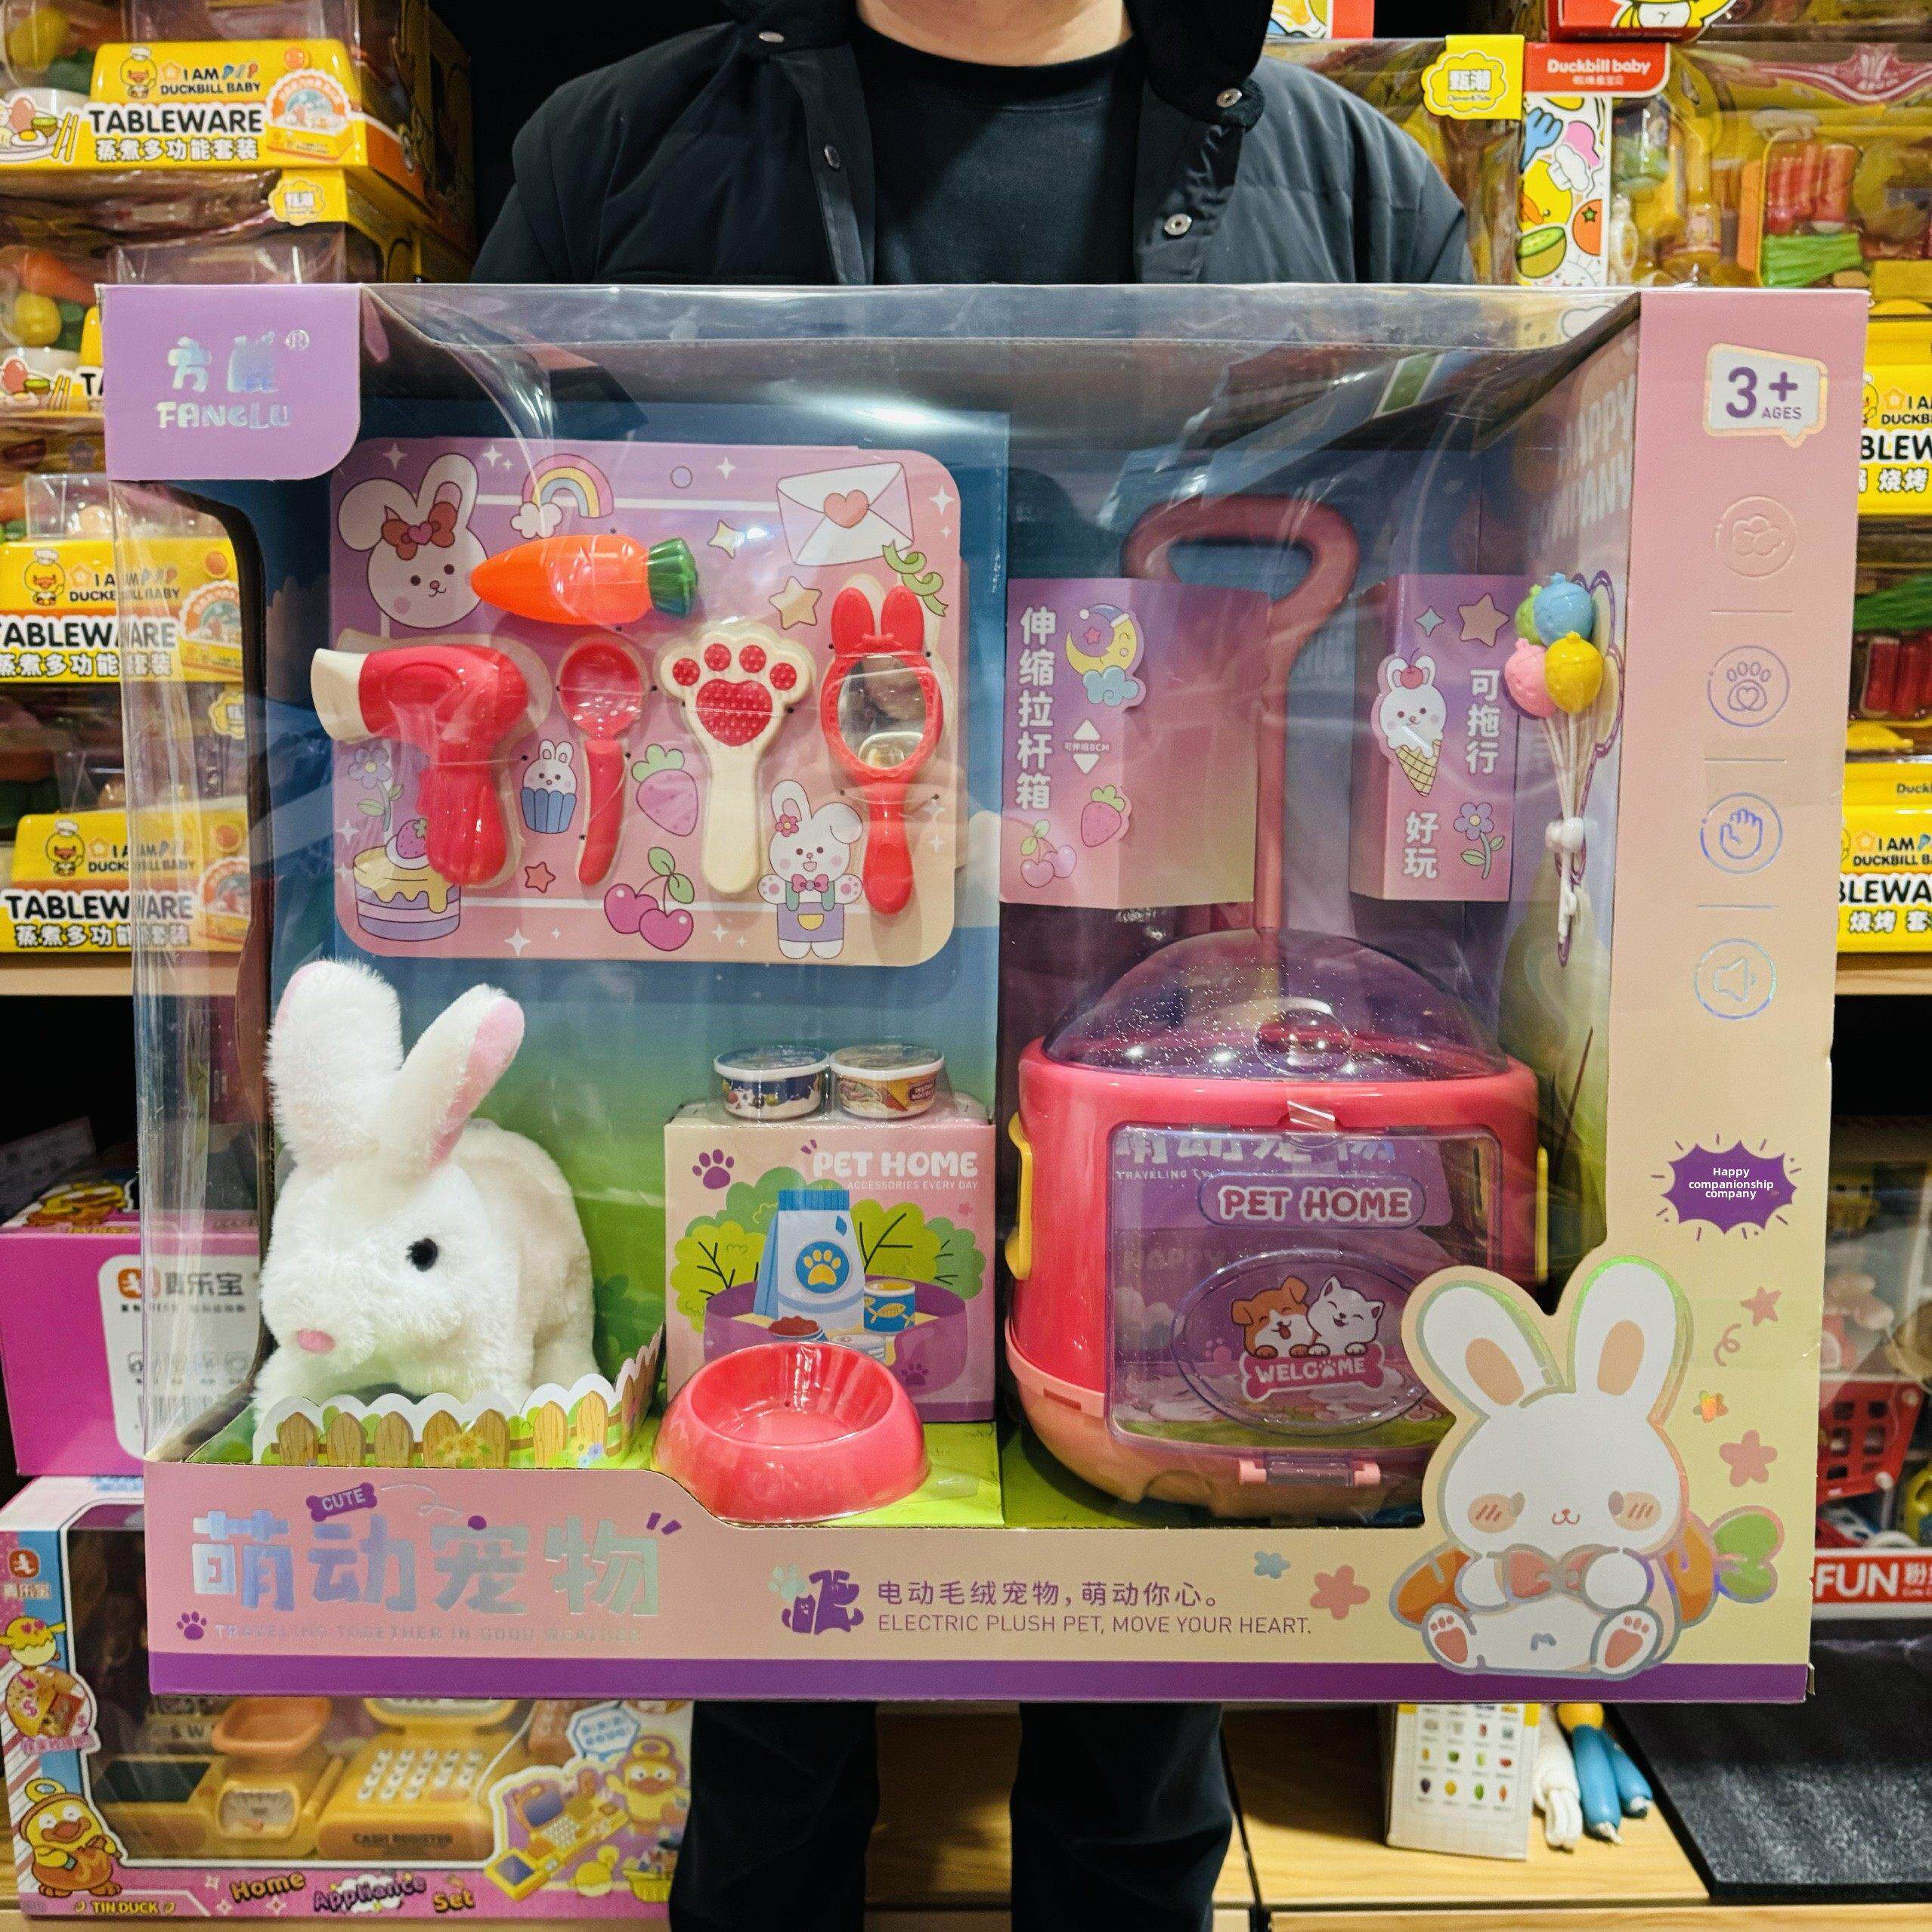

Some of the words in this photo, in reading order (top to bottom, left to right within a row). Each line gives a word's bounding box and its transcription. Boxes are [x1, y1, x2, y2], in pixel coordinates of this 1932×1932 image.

[192, 68, 219, 80] AM
[1547, 58, 1610, 73] Duckbill
[1612, 59, 1651, 75] baby
[160, 83, 224, 94] DUCKBILL
[227, 82, 261, 93] BABY
[89, 110, 262, 134] TABLEWARE
[95, 138, 258, 161] 蒸煮多功能套装
[1761, 407, 1803, 420] AGES
[1016, 605, 1057, 811] 伸缩拉杆箱
[1466, 668, 1501, 775] 可拖行
[1403, 810, 1439, 880] 好玩
[1887, 838, 1914, 850] AM
[1853, 856, 1918, 866] DUCKBILL
[813, 1151, 874, 1178] PET
[881, 1151, 978, 1178] HOME
[1115, 1169, 1187, 1181] TRAVELING
[847, 1180, 919, 1190] ACCESSORIES
[923, 1180, 955, 1190] EVERY
[959, 1180, 978, 1190] DAY
[1222, 1188, 1291, 1218] PET
[1302, 1188, 1410, 1219] HOME
[320, 1487, 367, 1511] CUTE
[192, 1509, 659, 1618] 萌动宠物
[1816, 1563, 1899, 1597] FUN
[878, 1615, 979, 1631] ELECTRIC
[986, 1615, 1055, 1632] PLUSH
[1064, 1615, 1104, 1634] PET,
[1113, 1615, 1170, 1633] MOVE
[1177, 1616, 1232, 1633] YOUR
[1240, 1616, 1311, 1634] HEART.
[231, 1872, 305, 1903] Home
[433, 1890, 475, 1913] Set
[92, 1901, 116, 1914] TIN
[119, 1901, 159, 1914] DUCK
